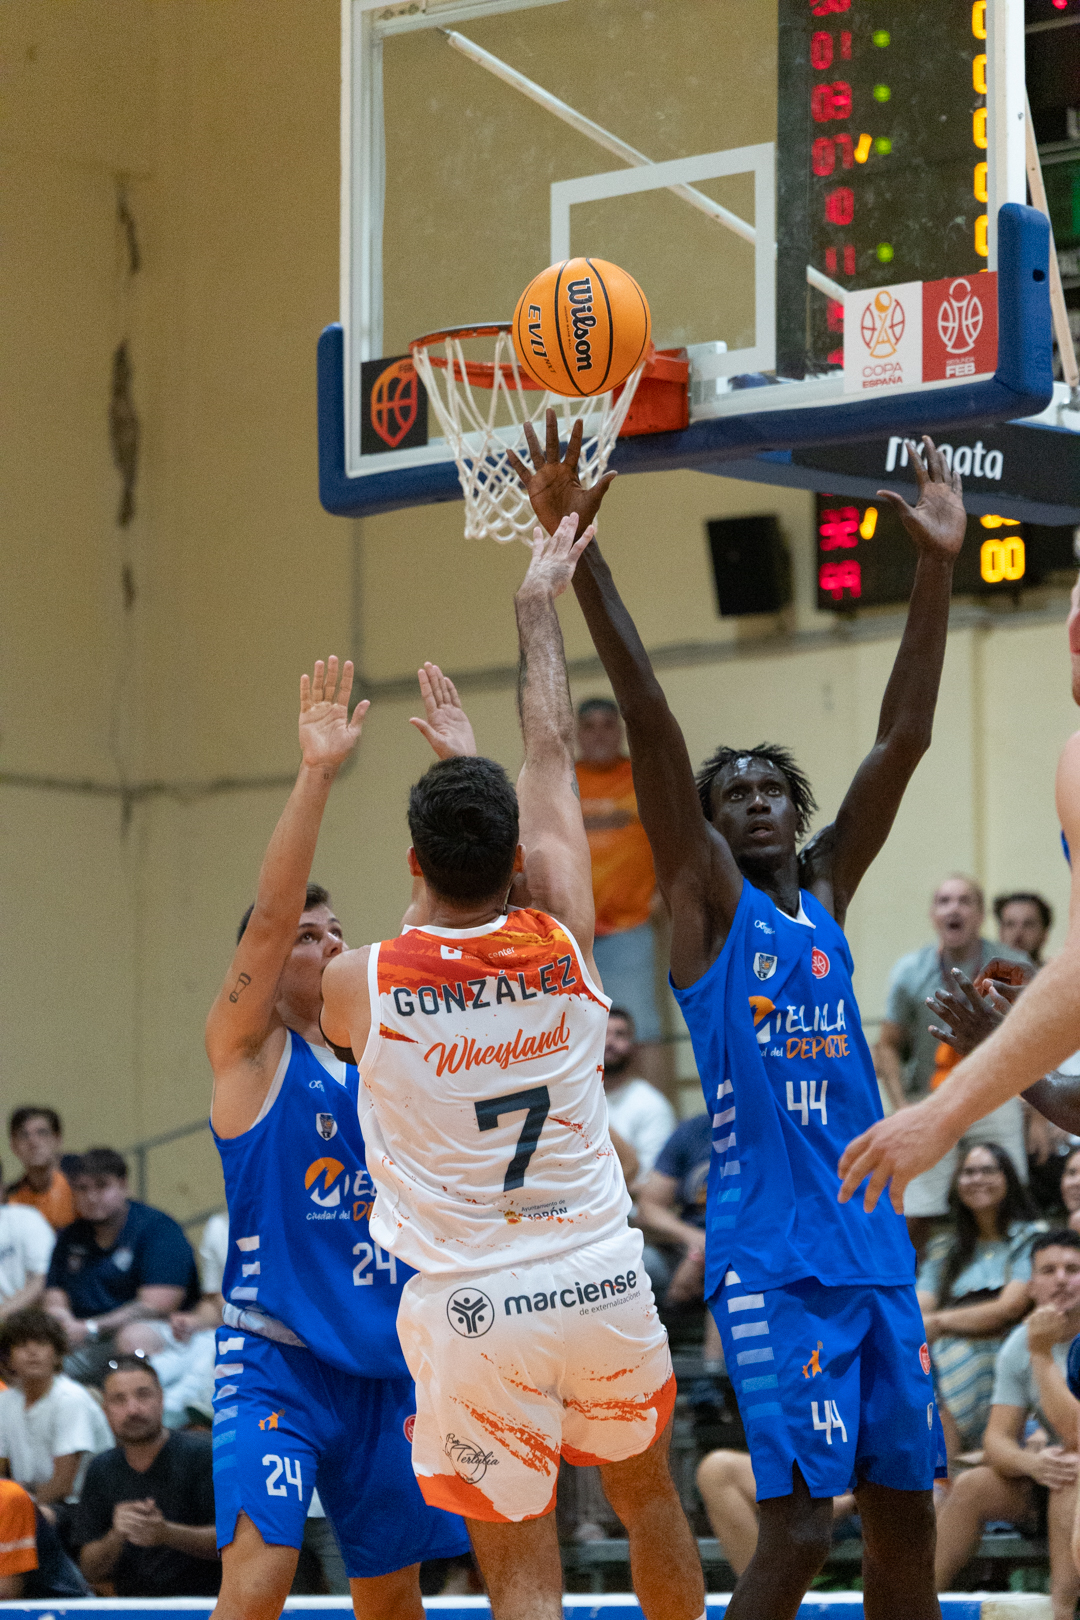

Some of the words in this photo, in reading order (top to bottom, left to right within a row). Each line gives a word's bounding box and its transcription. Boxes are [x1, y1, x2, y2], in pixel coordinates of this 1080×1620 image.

[567, 277, 597, 372] Wilson
[862, 362, 904, 378] COPA
[862, 374, 904, 389] ESPAÑA
[946, 362, 977, 379] FEB
[392, 953, 577, 1017] GONZÁLEZ
[423, 1011, 570, 1077] Wheyland
[786, 1034, 851, 1060] DEPORTE
[786, 1080, 828, 1126] 44
[474, 1085, 551, 1192] 7
[521, 1201, 558, 1212] Ayuntamiento
[353, 1242, 398, 1286] 24
[504, 1270, 637, 1316] marciense
[579, 1307, 590, 1316] de
[591, 1290, 641, 1313] externalizaciones
[262, 1454, 303, 1501] 24
